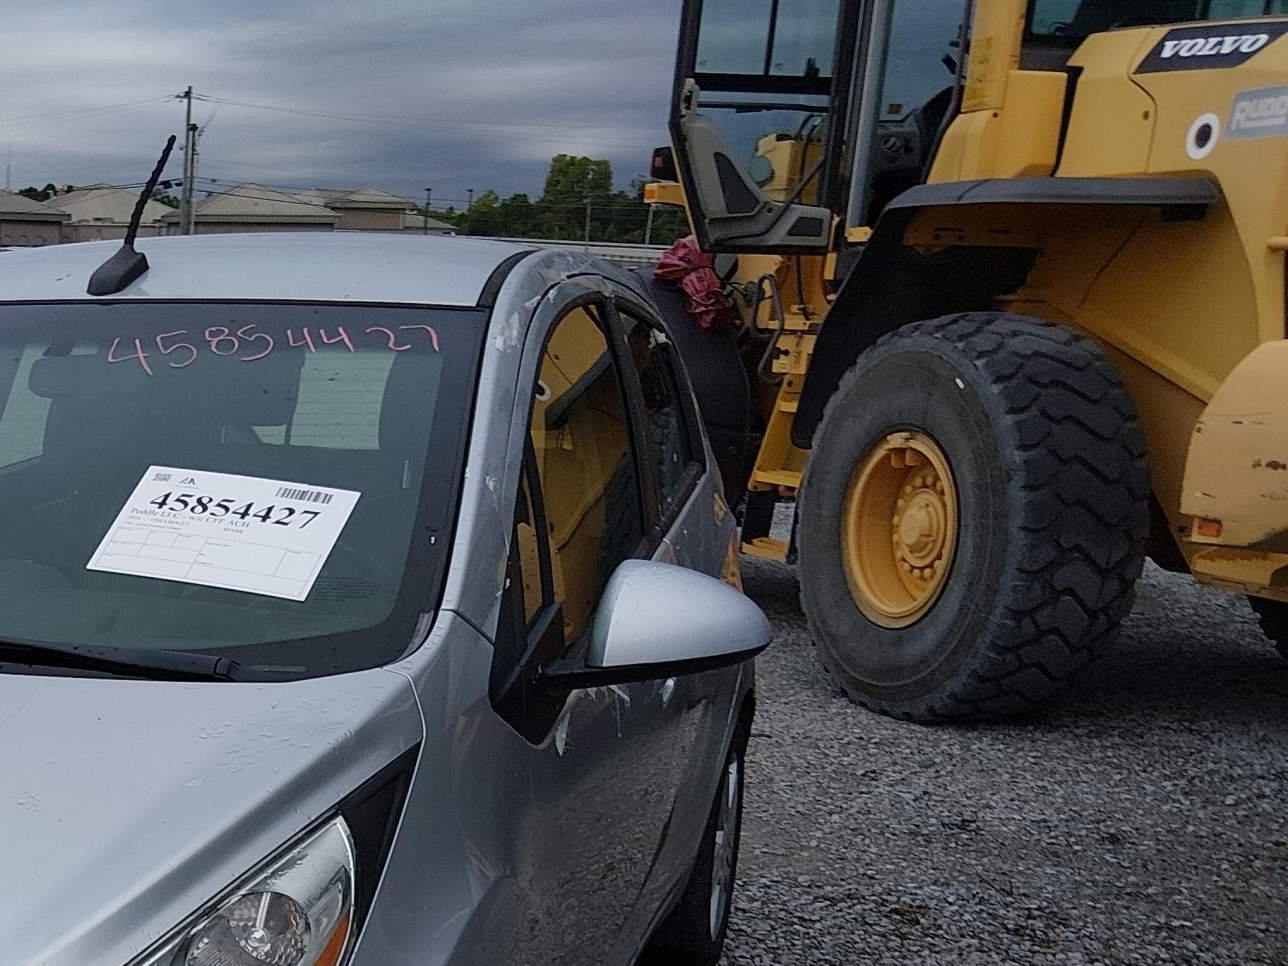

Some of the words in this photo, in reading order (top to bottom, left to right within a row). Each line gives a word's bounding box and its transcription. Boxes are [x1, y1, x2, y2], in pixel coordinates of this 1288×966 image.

[1160, 34, 1269, 58] VOLVO
[107, 324, 440, 377] 45854427
[150, 490, 321, 529] 45854427
